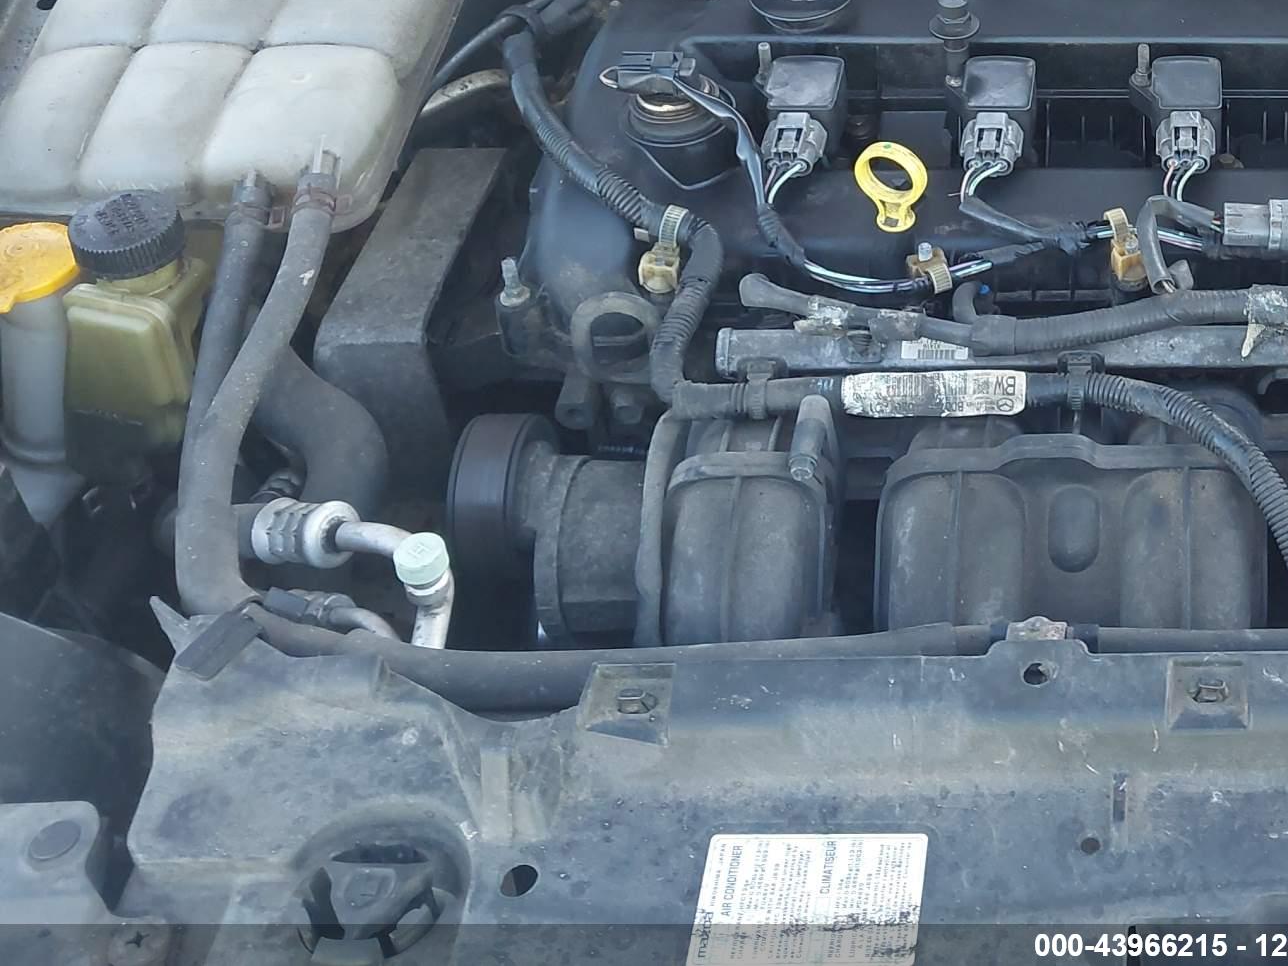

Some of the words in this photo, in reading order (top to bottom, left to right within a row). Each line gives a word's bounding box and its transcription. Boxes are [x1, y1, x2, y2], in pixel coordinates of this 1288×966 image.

[994, 376, 1016, 396] BW
[723, 845, 743, 899] CONDITIONER
[819, 840, 837, 893] CLIMATISEUR
[720, 902, 733, 916] AIR
